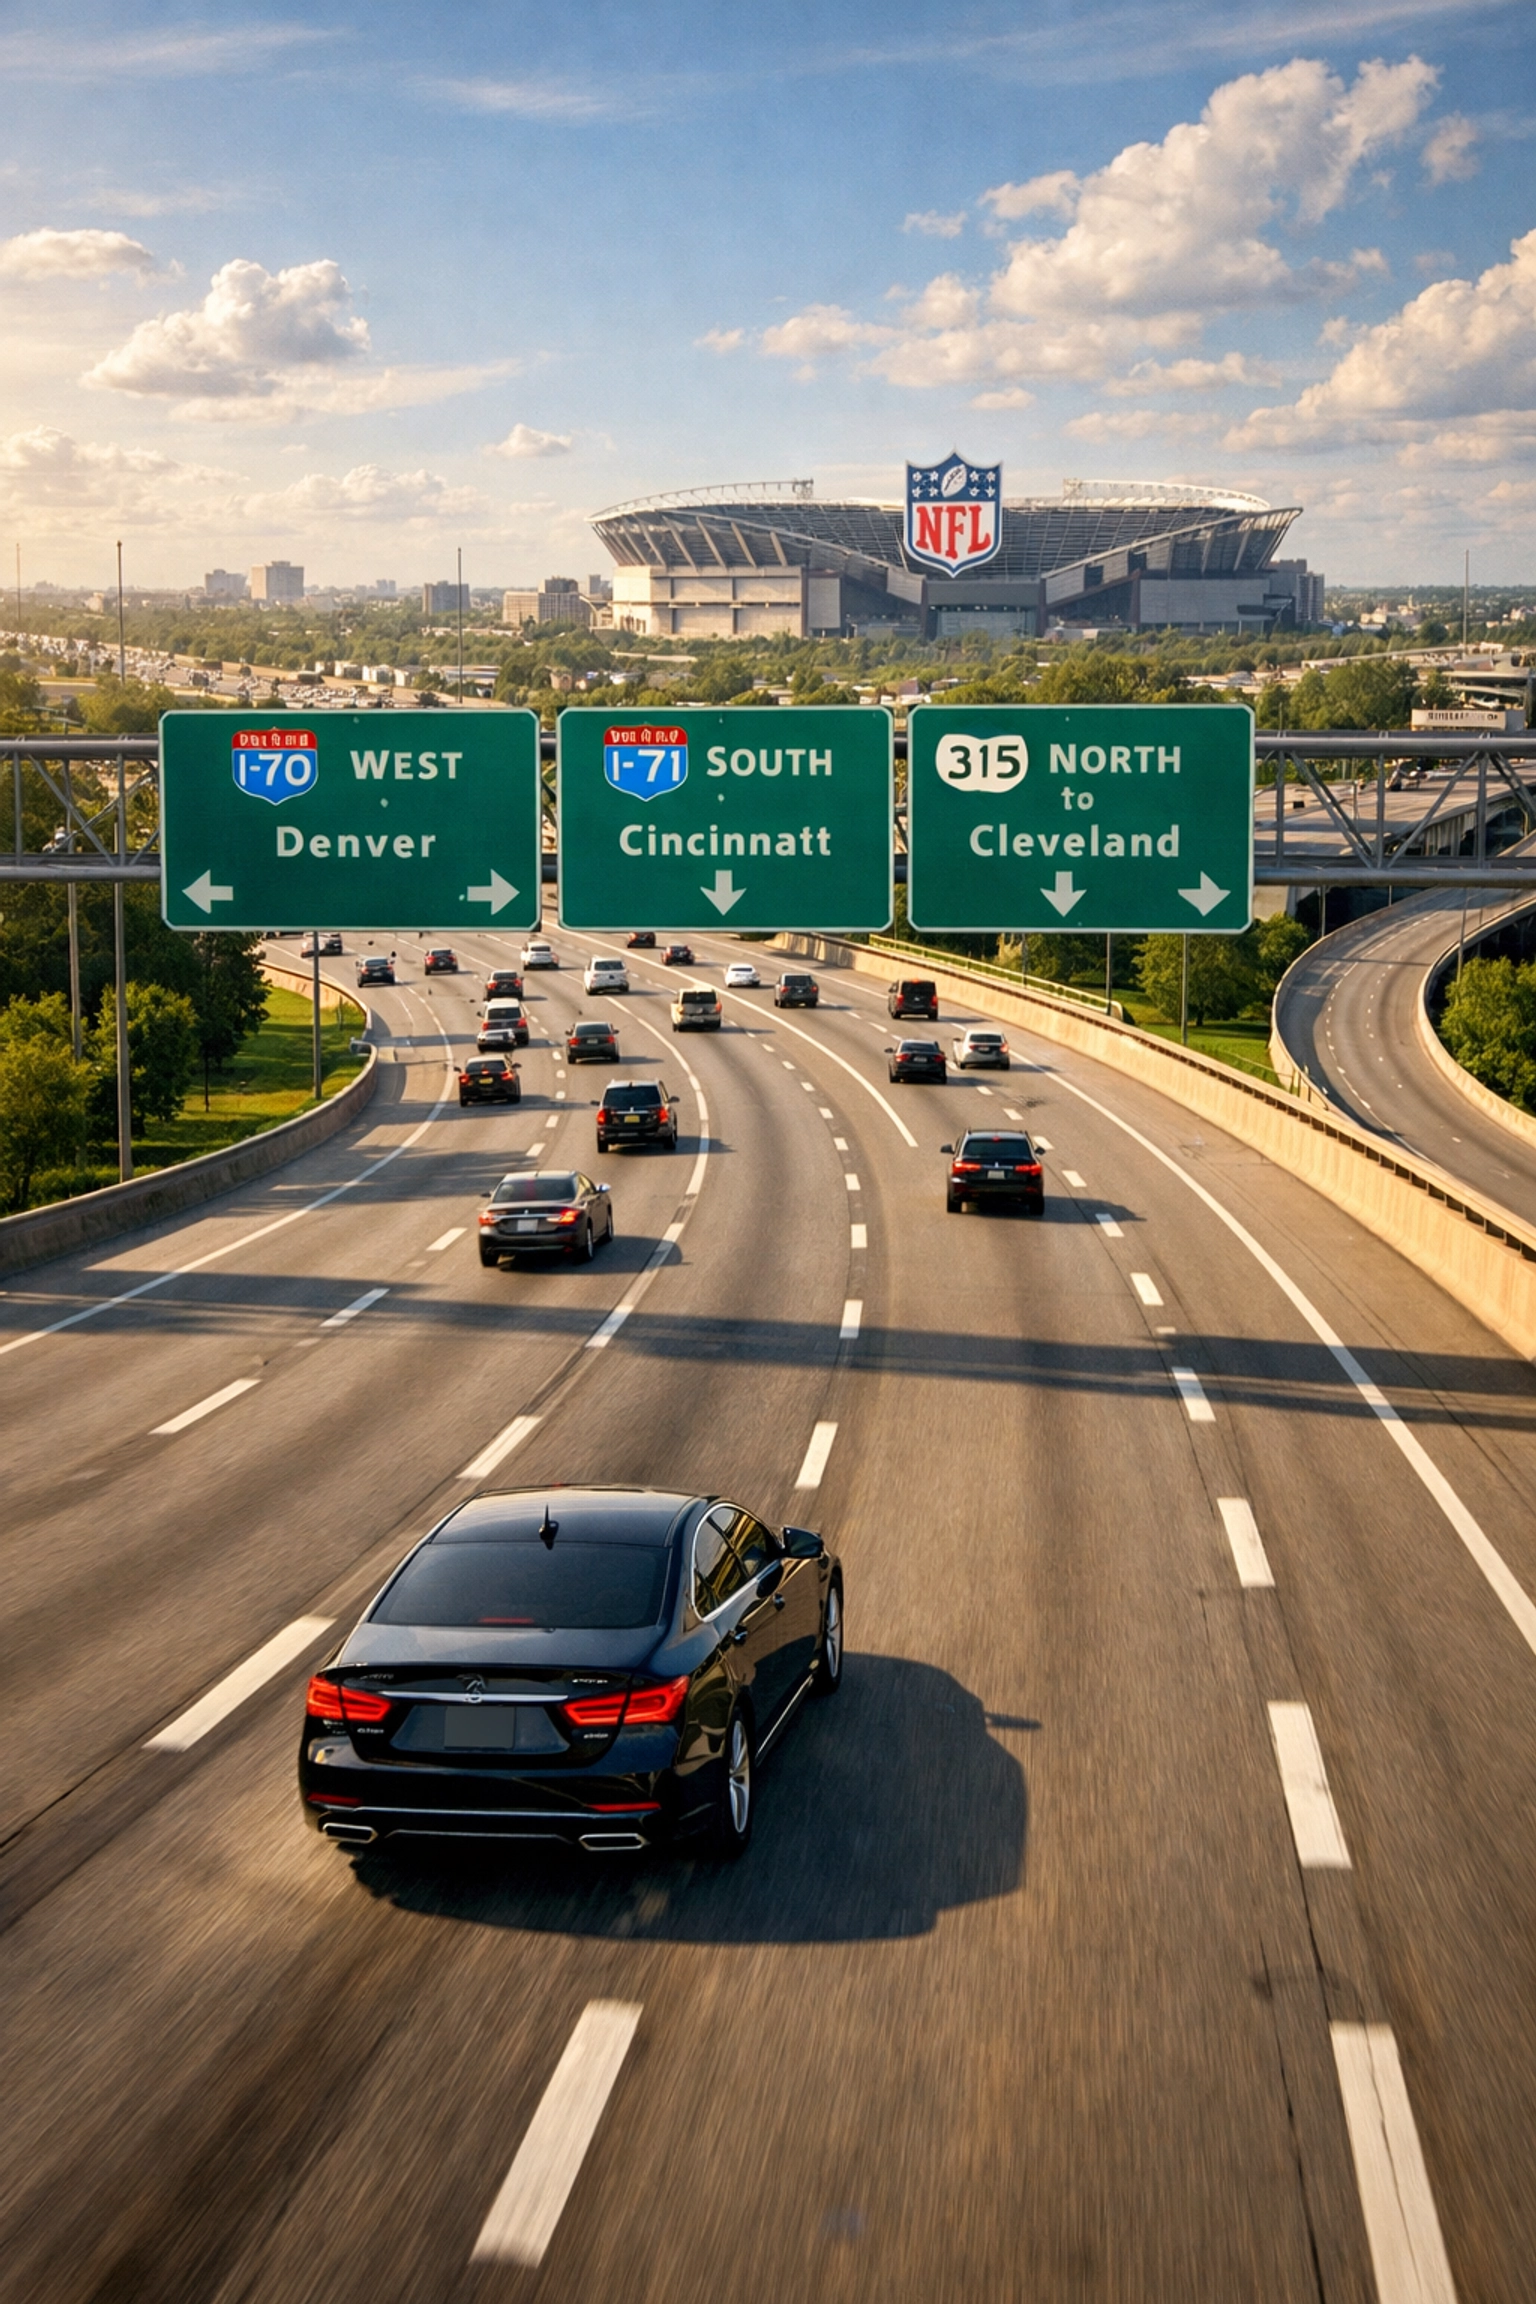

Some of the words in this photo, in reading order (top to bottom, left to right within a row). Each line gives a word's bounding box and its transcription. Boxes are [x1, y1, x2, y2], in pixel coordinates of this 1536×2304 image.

[915, 504, 991, 560] NFL
[239, 753, 312, 786] I-70
[350, 750, 463, 780] WEST
[612, 749, 680, 782] I-71
[706, 746, 833, 777] SOUTH
[948, 745, 1021, 780] 315
[1050, 744, 1181, 774] NORTH
[1060, 786, 1095, 811] to
[276, 826, 436, 858] Denver
[619, 824, 831, 856] Cincinnatt
[969, 823, 1180, 858] Cleveland
